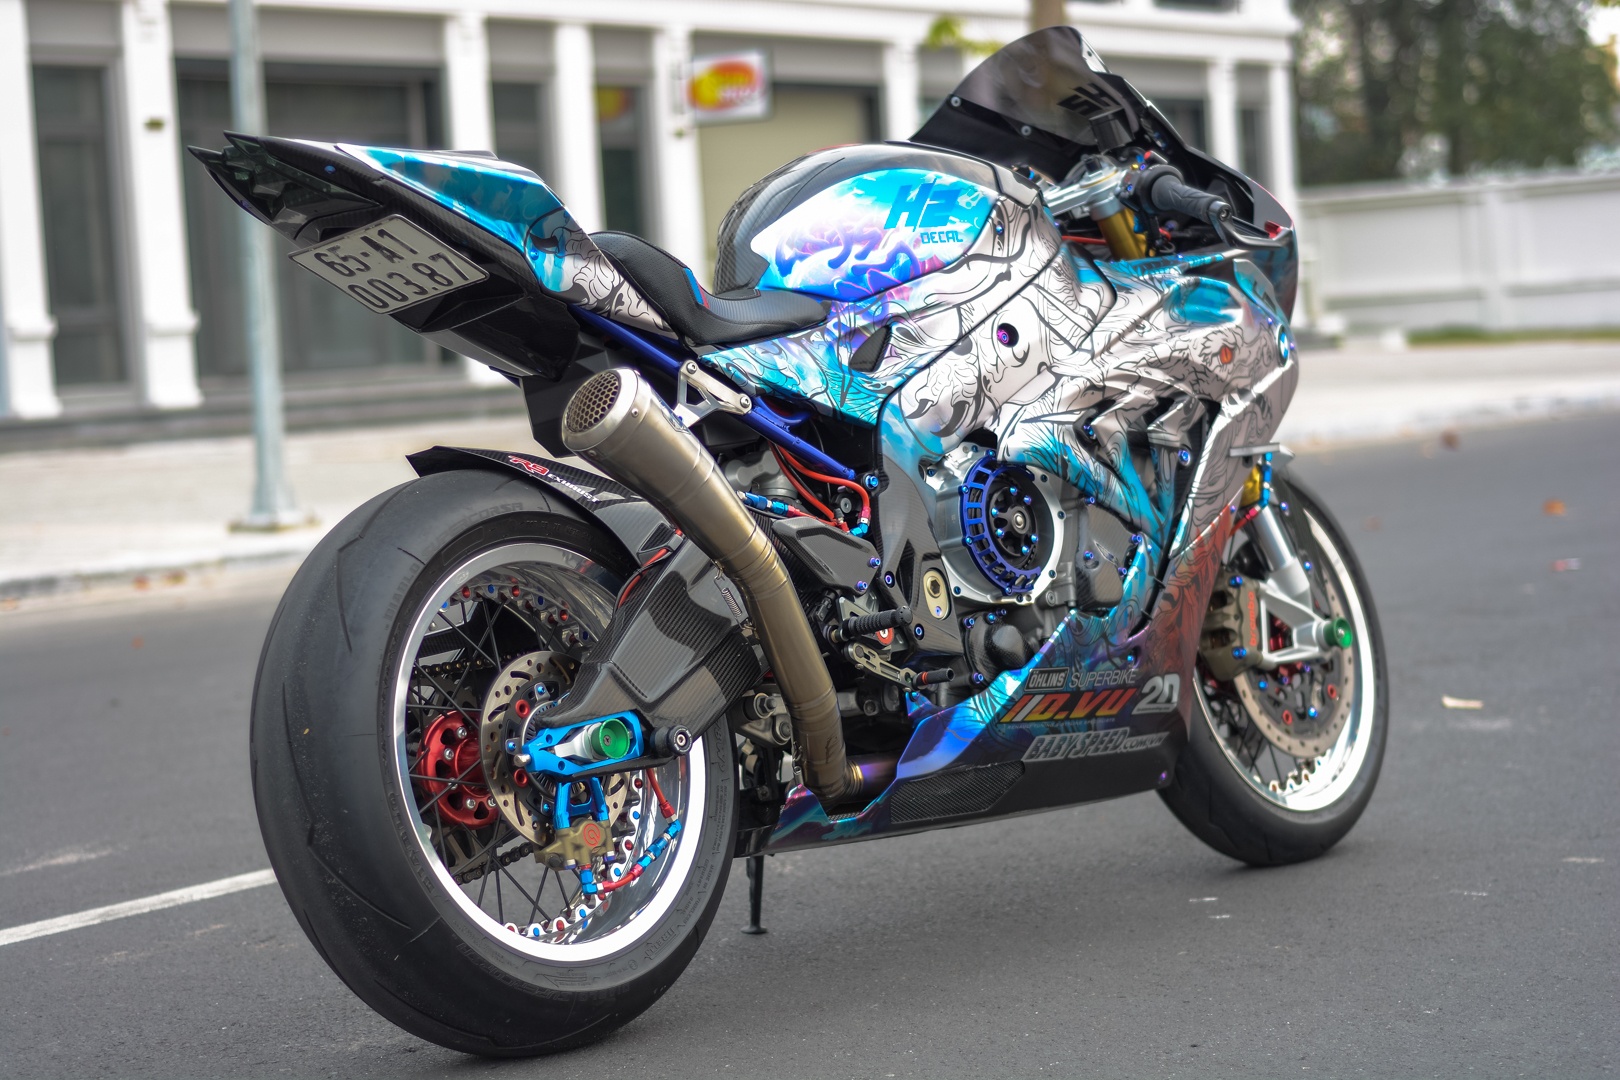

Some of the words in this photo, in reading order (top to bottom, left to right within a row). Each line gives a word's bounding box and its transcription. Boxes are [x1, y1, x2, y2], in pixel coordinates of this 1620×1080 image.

[919, 230, 964, 244] DECAL
[347, 252, 470, 309] 003.87
[547, 473, 600, 503] EXHAUST
[1029, 671, 1067, 688] ÖHLINS
[1069, 669, 1138, 689] SUPERBIKE
